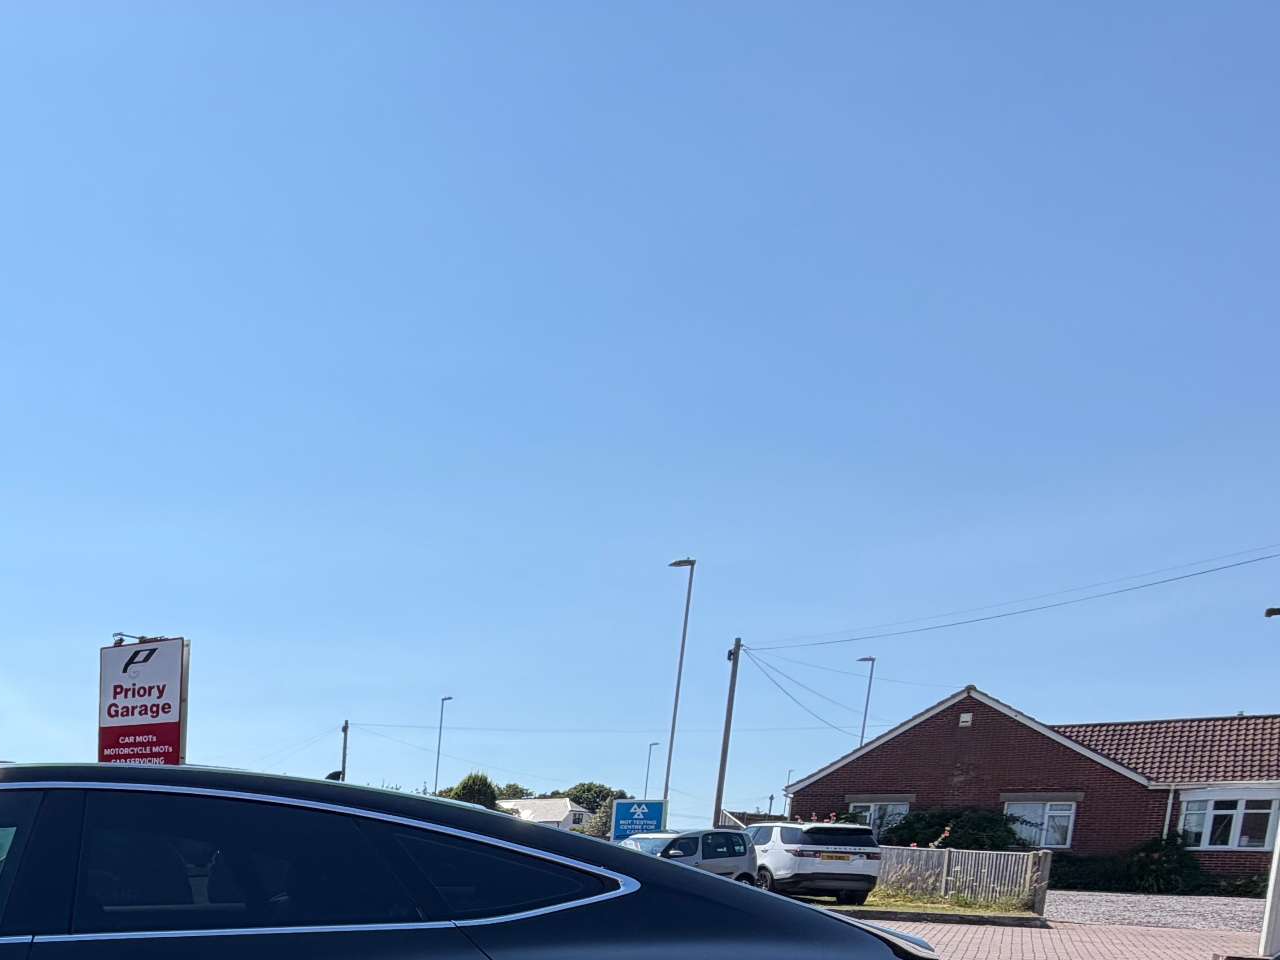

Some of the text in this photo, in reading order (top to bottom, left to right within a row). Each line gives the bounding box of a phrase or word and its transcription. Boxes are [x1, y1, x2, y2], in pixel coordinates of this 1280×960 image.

[112, 683, 166, 700] Priory
[107, 702, 172, 718] Garage
[118, 734, 157, 744] CAR MOTs
[103, 745, 173, 756] MOTORCYCLE MOTs
